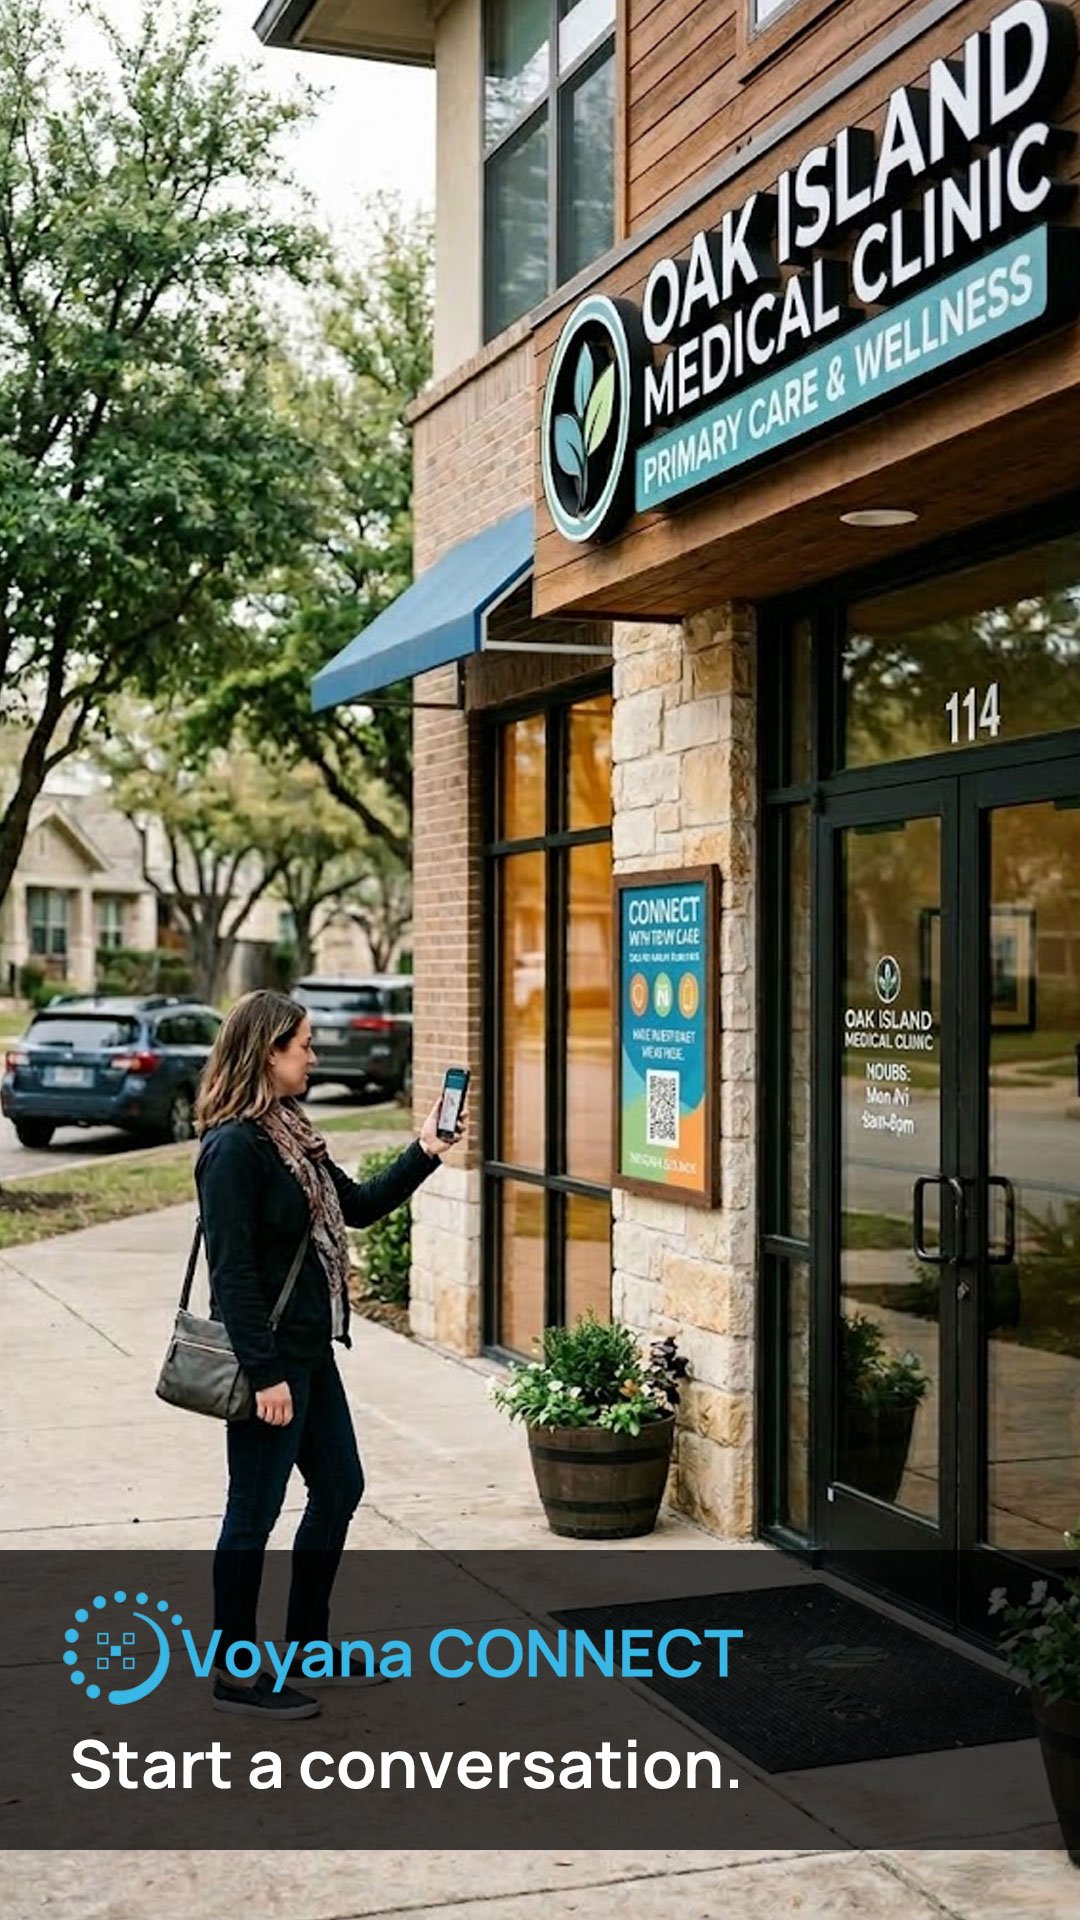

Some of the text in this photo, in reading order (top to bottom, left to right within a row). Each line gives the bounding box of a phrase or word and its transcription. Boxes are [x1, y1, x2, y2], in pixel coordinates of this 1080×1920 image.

[642, 0, 1049, 344] OAK ISLAND
[644, 122, 1052, 427] MEDICAL CLINIC
[643, 253, 1034, 494] PRIMARY CARE & WELLNESS
[945, 682, 1001, 744] 114
[629, 896, 700, 925] CONNECT
[845, 1009, 933, 1031] OAK ISLAND
